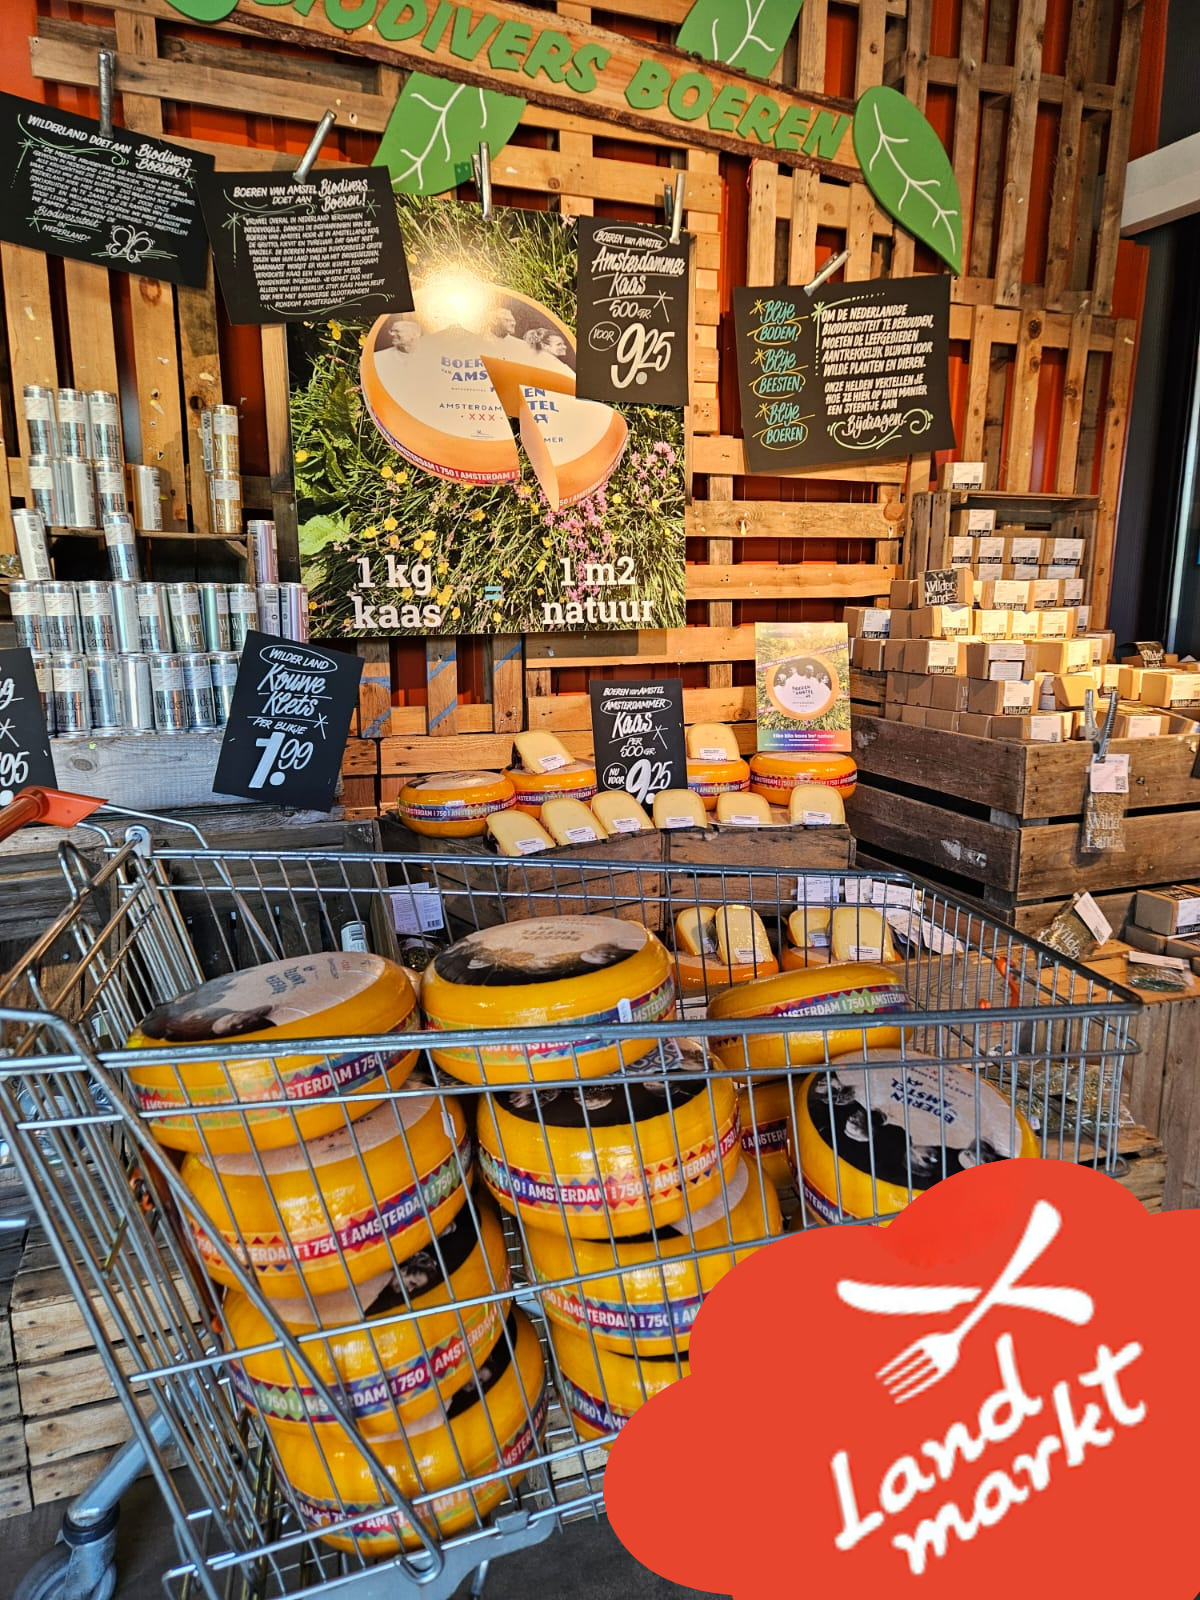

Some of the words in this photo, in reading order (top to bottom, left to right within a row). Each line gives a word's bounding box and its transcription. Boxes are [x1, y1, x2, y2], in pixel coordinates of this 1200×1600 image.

[254, 0, 611, 93] ODIVERS
[624, 59, 851, 161] BOEREN
[27, 115, 88, 141] WILDERLAND
[89, 135, 110, 149] DOET
[111, 144, 132, 154] AAN
[136, 144, 192, 168] Biodivers
[136, 159, 188, 178] Boeren!
[233, 186, 268, 198] BOEREN
[269, 185, 285, 196] VAN
[287, 184, 318, 194] AMSTEL
[318, 178, 368, 197] Biodivers
[272, 196, 294, 204] DOET
[295, 196, 312, 204] AAN
[321, 193, 366, 212] Boeren!
[34, 206, 101, 228] Biodiversiteit
[596, 230, 624, 243] BOEREN
[636, 238, 664, 250] AMSTEL
[591, 246, 685, 275] Amsterdammer
[609, 271, 646, 296] Kaas
[609, 300, 638, 318] 500
[760, 300, 796, 324] Blije
[822, 310, 835, 322] OM
[837, 308, 848, 320] DE
[850, 304, 908, 320] NEDERLANDSE
[760, 326, 798, 342] BODEM,
[822, 320, 880, 335] BIODIVERSITEIT
[882, 319, 891, 330] TE
[892, 314, 934, 329] BEHOUDEN,
[593, 328, 614, 342] VOOR
[822, 334, 853, 349] MOETEN
[854, 334, 864, 346] DE
[865, 330, 919, 345] LEEFGEBIEDEN
[611, 323, 675, 389] 9.25
[761, 349, 796, 373] Blije
[822, 346, 883, 363] AANTREKKELIJK
[884, 344, 912, 357] BLIJVEN
[912, 342, 933, 354] VOOR
[824, 362, 848, 377] WILDE
[850, 359, 884, 374] PLANTEN
[886, 358, 896, 371] EN
[897, 356, 927, 370] DIEREN.
[524, 388, 546, 398] EN
[759, 377, 802, 394] BEESTEN,
[824, 381, 844, 393] ONZE
[845, 378, 873, 391] HELDEN
[875, 375, 913, 389] VERTELLEN
[914, 373, 924, 384] JE
[826, 392, 840, 404] HOE
[842, 391, 852, 401] ZE
[853, 390, 870, 401] HIER
[871, 389, 881, 400] OP
[882, 388, 898, 399] HUN
[899, 385, 928, 397] MANIER
[439, 403, 502, 411] AMSTERDAM
[765, 403, 800, 427] Blije
[827, 403, 842, 416] EEN
[844, 401, 879, 413] STEENTJE
[880, 399, 898, 410] AAN
[766, 427, 803, 444] BOEREN
[440, 467, 454, 476] 750
[460, 471, 510, 480] AMSTERDAM
[357, 557, 375, 588] 1
[384, 555, 431, 596] kg
[559, 558, 574, 588] 1
[584, 555, 635, 586] m2
[926, 580, 956, 592] Wilder
[926, 593, 950, 605] Land
[352, 596, 442, 629] kaas
[542, 600, 656, 625] natuur
[269, 648, 301, 664] WILDER
[304, 658, 329, 670] LAND
[603, 688, 628, 696] BOEREN
[638, 686, 664, 695] AMSTEL
[262, 691, 318, 717] Klets
[604, 700, 666, 711] AMSTERDAMMER
[253, 718, 272, 729] PER
[273, 722, 308, 735] BLIKJE
[612, 712, 653, 738] Kaas
[248, 731, 314, 789] 1.99
[620, 746, 643, 757] 500
[608, 776, 625, 784] VOOR
[609, 768, 620, 776] NU
[437, 808, 447, 817] 750
[849, 998, 863, 1009] 750
[871, 993, 905, 1005] AMSTERDAM
[529, 1182, 607, 1203] AMSTERDAM
[619, 1181, 642, 1198] 750
[653, 1148, 720, 1190] AMSTERDAM
[350, 1190, 430, 1243] AMSTERDAM
[436, 1174, 453, 1195] 750
[563, 1303, 637, 1328] AMSTERDAM
[268, 1394, 287, 1410] 750
[397, 1367, 424, 1393] 750
[579, 1400, 595, 1418] 750
